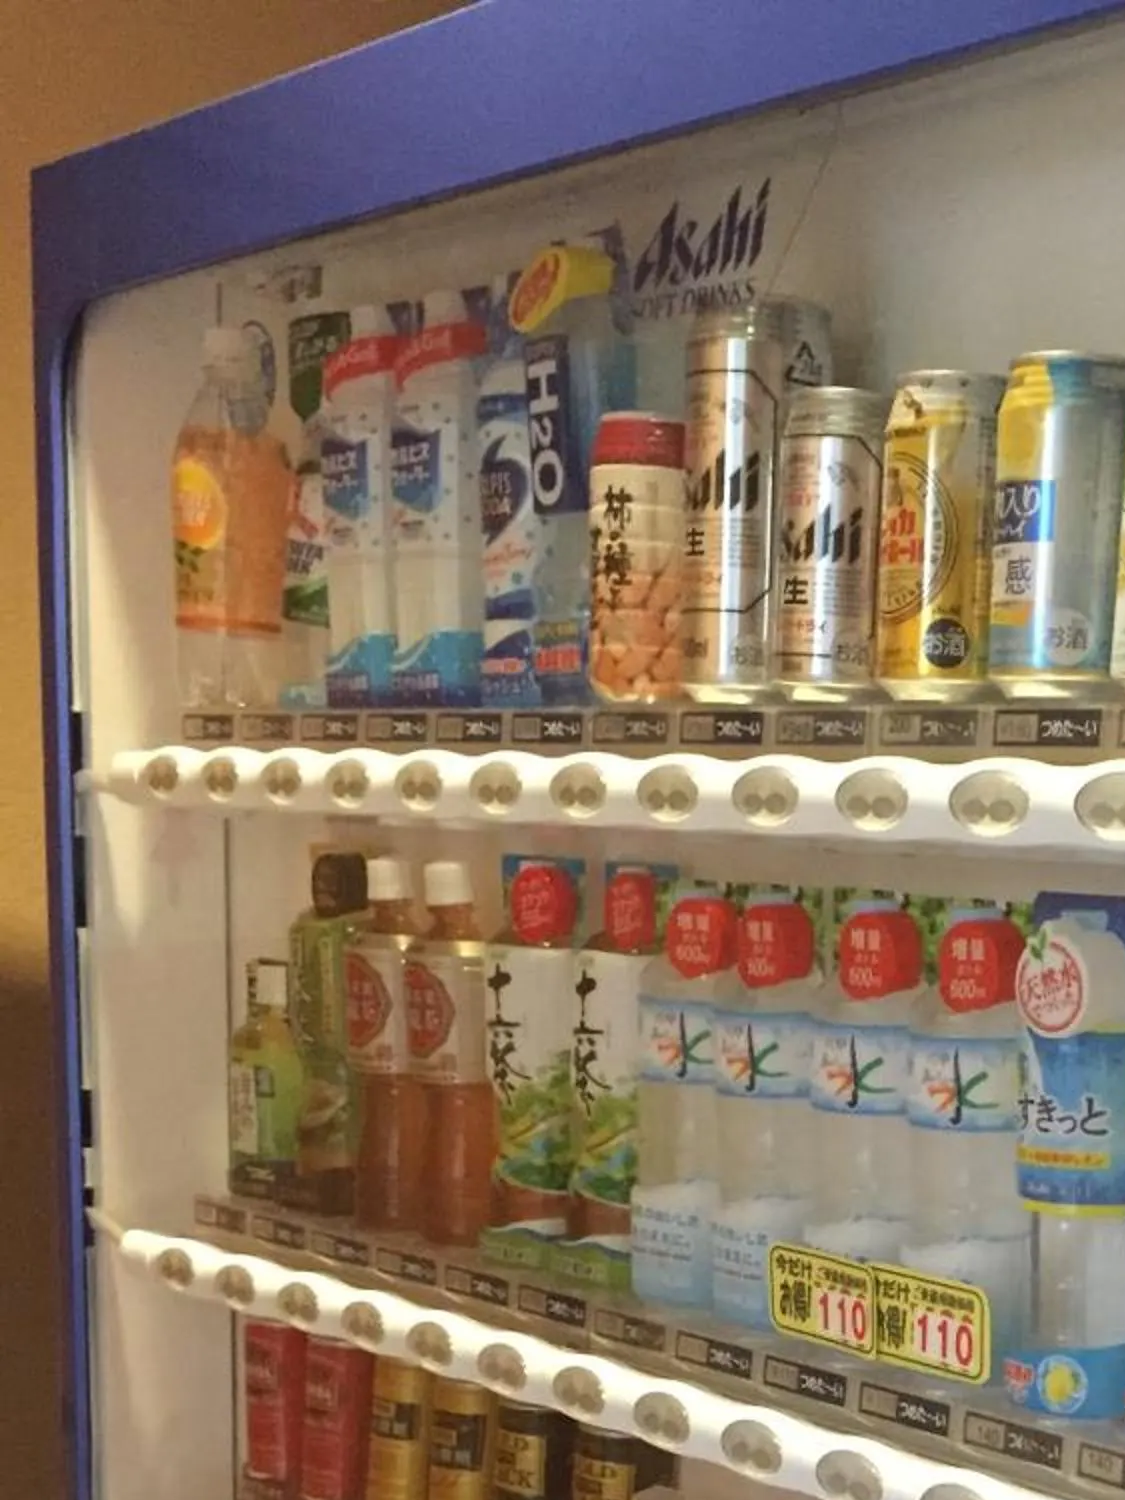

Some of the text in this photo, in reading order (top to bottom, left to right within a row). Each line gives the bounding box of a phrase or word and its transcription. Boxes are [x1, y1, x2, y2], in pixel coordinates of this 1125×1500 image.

[635, 177, 771, 292] Asahi
[686, 527, 705, 557] 生
[784, 575, 809, 605] 生
[925, 626, 965, 658] お酒
[1044, 622, 1090, 652] お酒
[486, 963, 532, 1106] 十六茶
[574, 968, 613, 1122] 十六茶
[1017, 1096, 1109, 1136] すきっと
[819, 1292, 866, 1341] 110
[917, 1314, 973, 1367] 110
